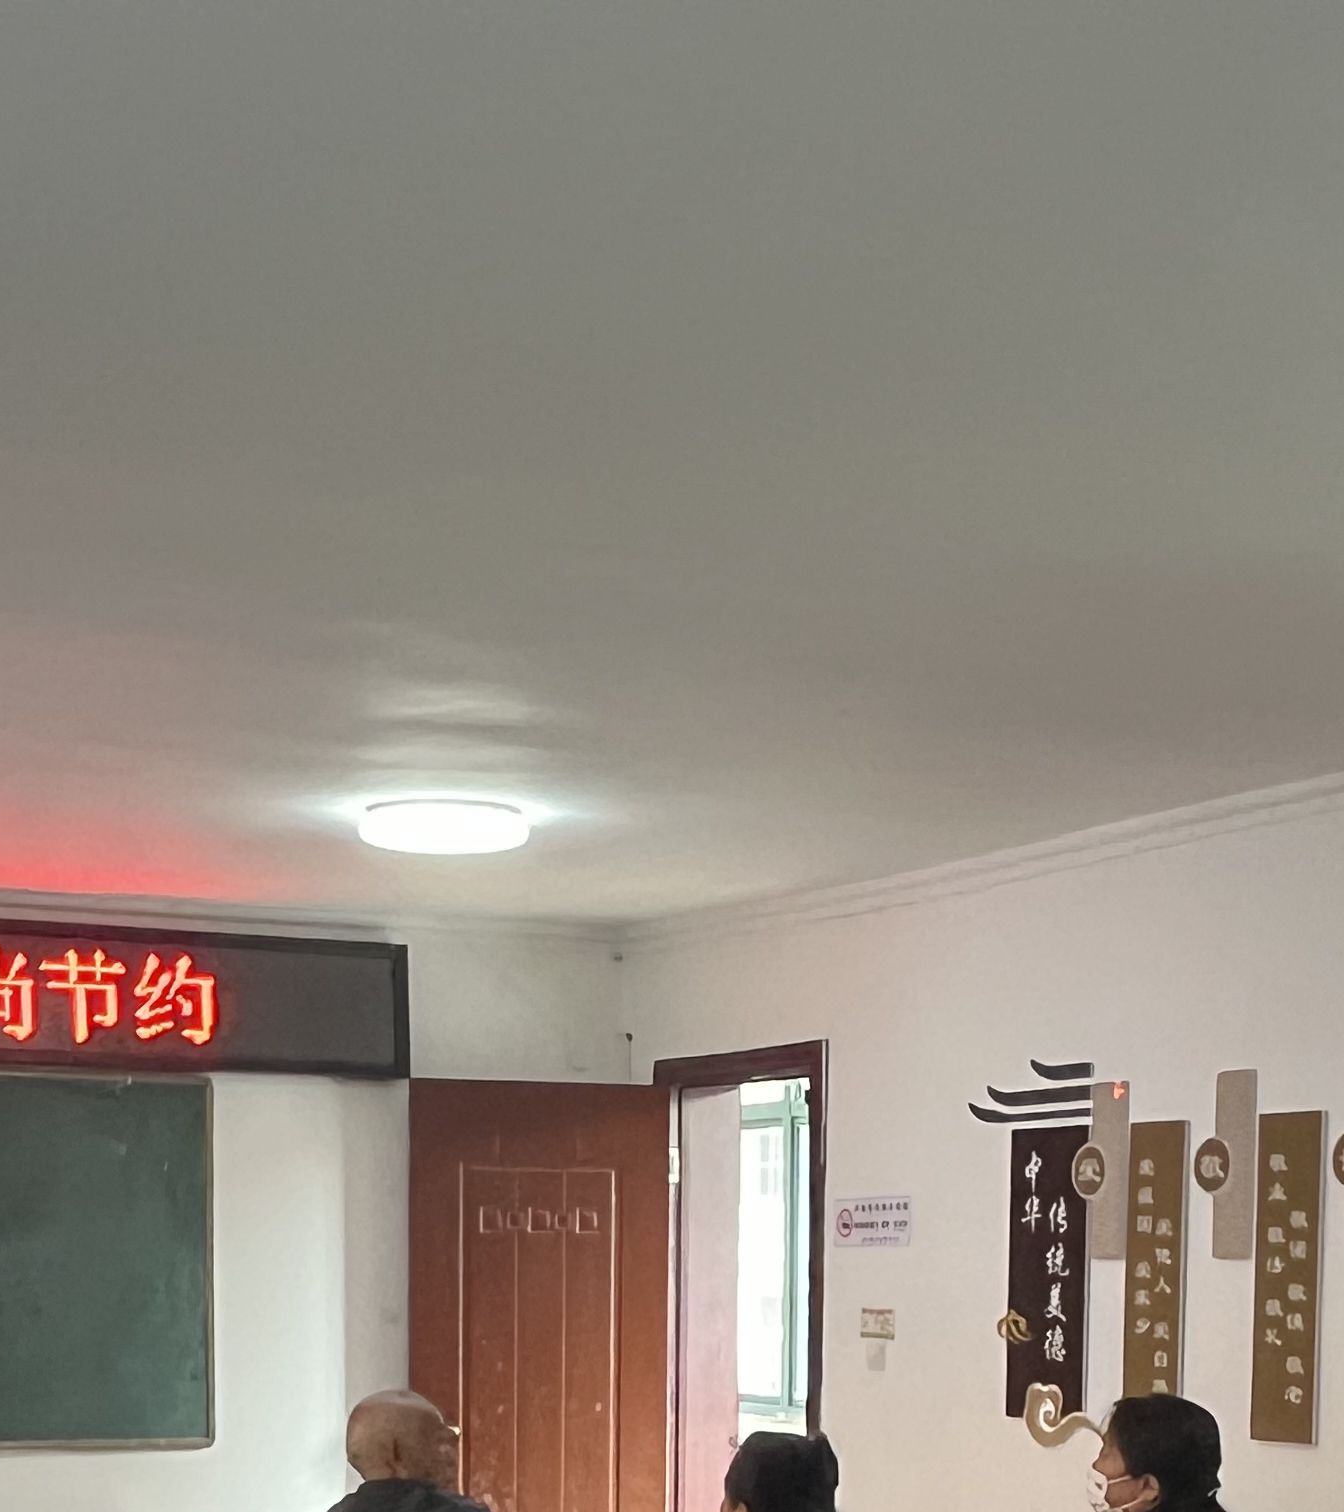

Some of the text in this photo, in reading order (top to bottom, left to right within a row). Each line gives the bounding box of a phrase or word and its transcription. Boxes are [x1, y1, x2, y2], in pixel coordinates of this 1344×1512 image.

[1020, 1150, 1043, 1233] 中华
[1044, 1196, 1070, 1362] 传统美德
